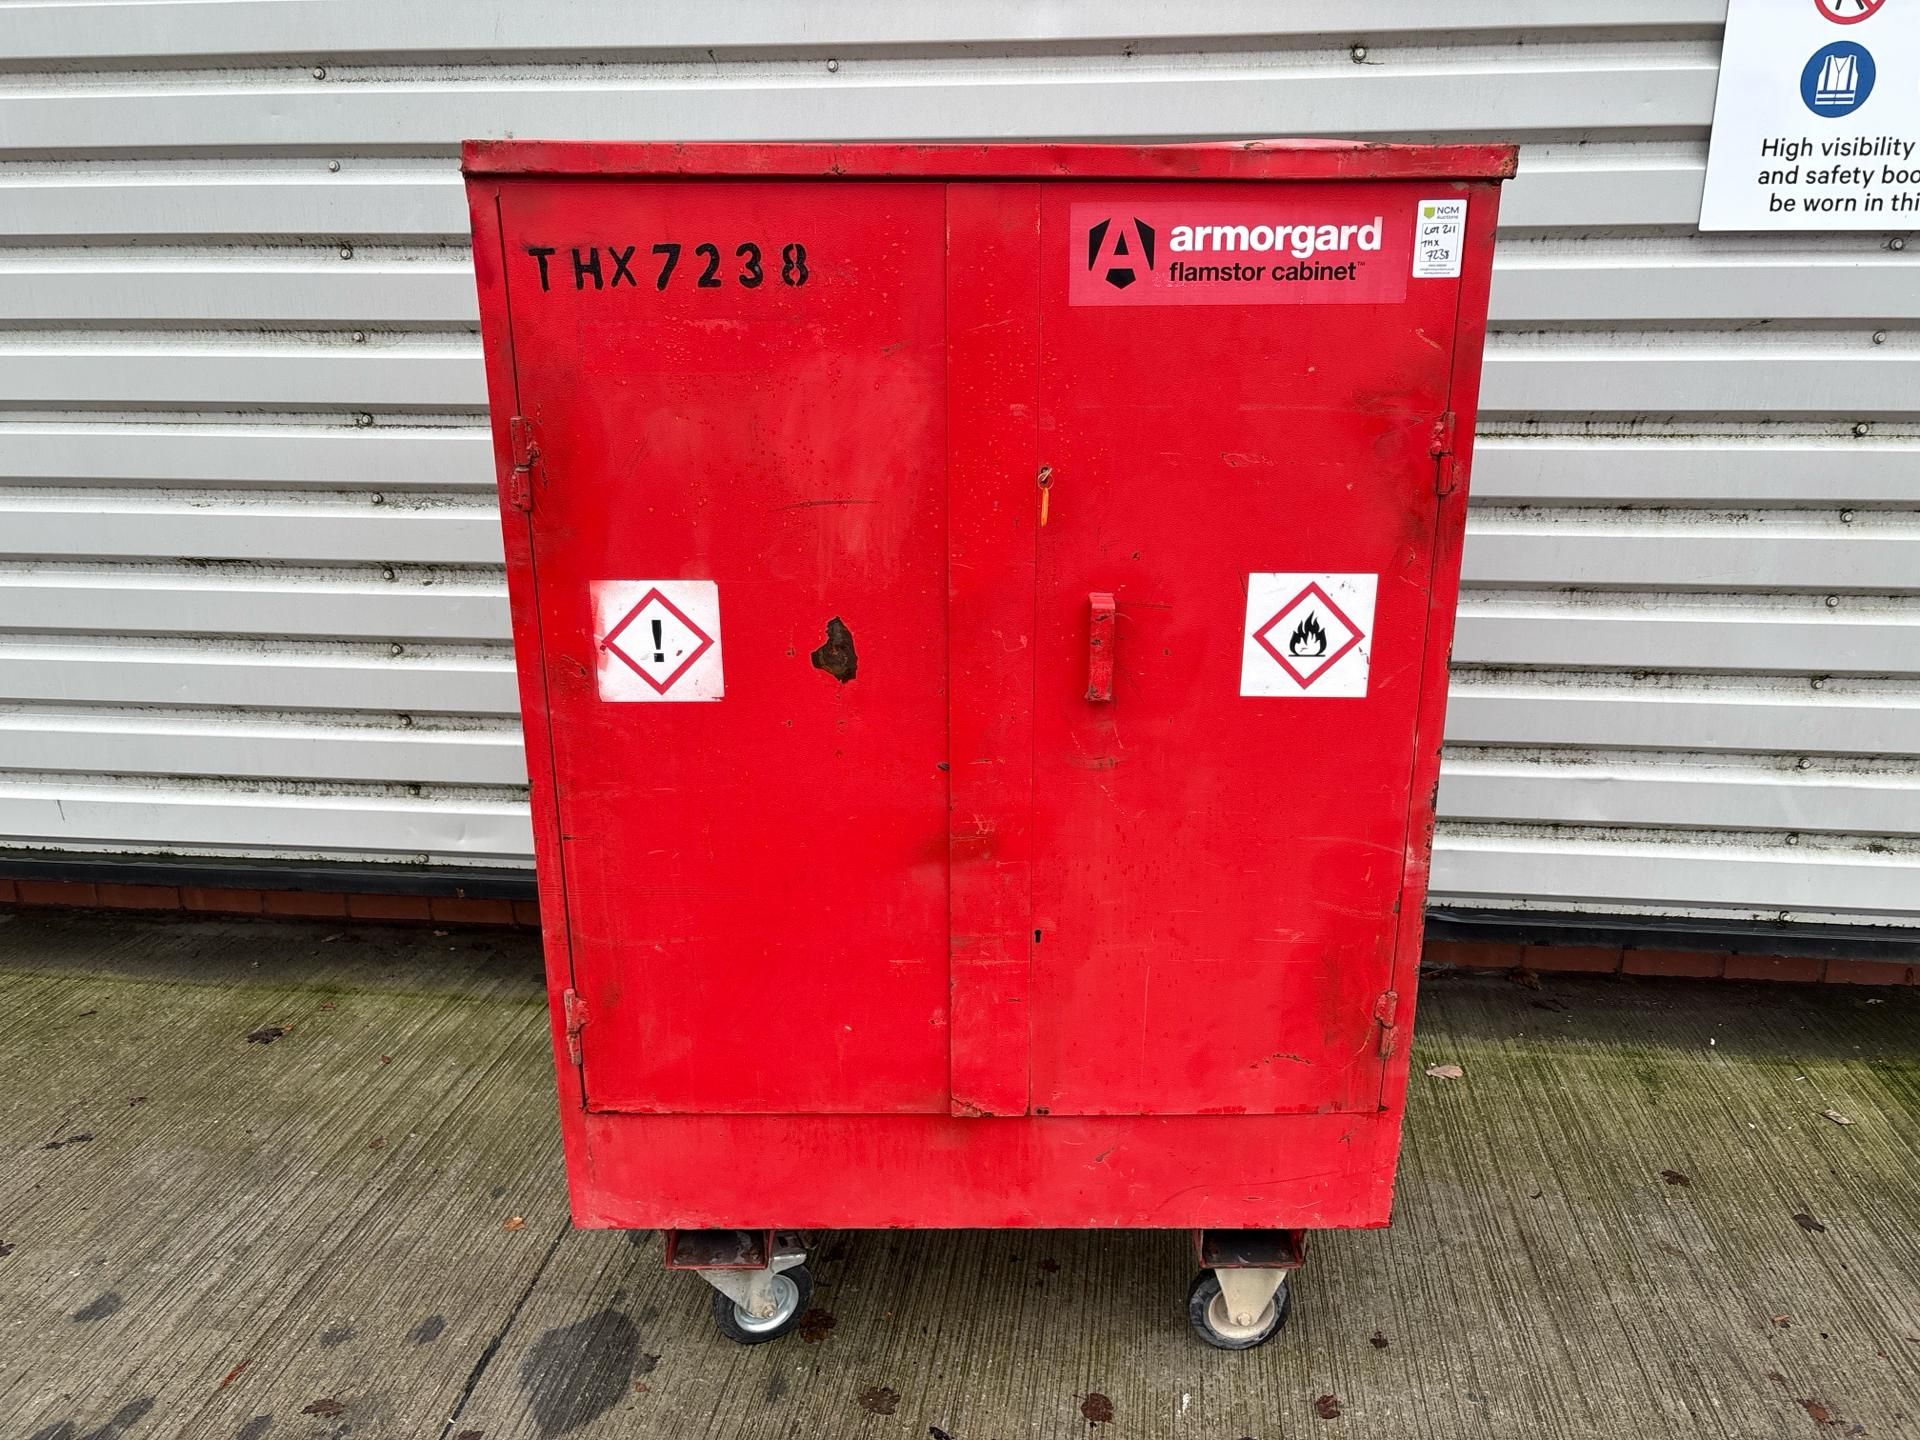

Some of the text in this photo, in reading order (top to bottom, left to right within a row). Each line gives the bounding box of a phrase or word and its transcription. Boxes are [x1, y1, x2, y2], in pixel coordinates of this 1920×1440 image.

[1761, 136, 1916, 161] High visibility
[1757, 165, 1799, 185] and
[1805, 164, 1875, 189] safety
[1437, 207, 1459, 215] NCM
[1769, 192, 1796, 212] be
[1803, 198, 1857, 212] worn
[1864, 193, 1884, 211] in
[1169, 216, 1383, 258] armorgard
[1442, 225, 1456, 234] 211
[1169, 262, 1264, 282] flamstor
